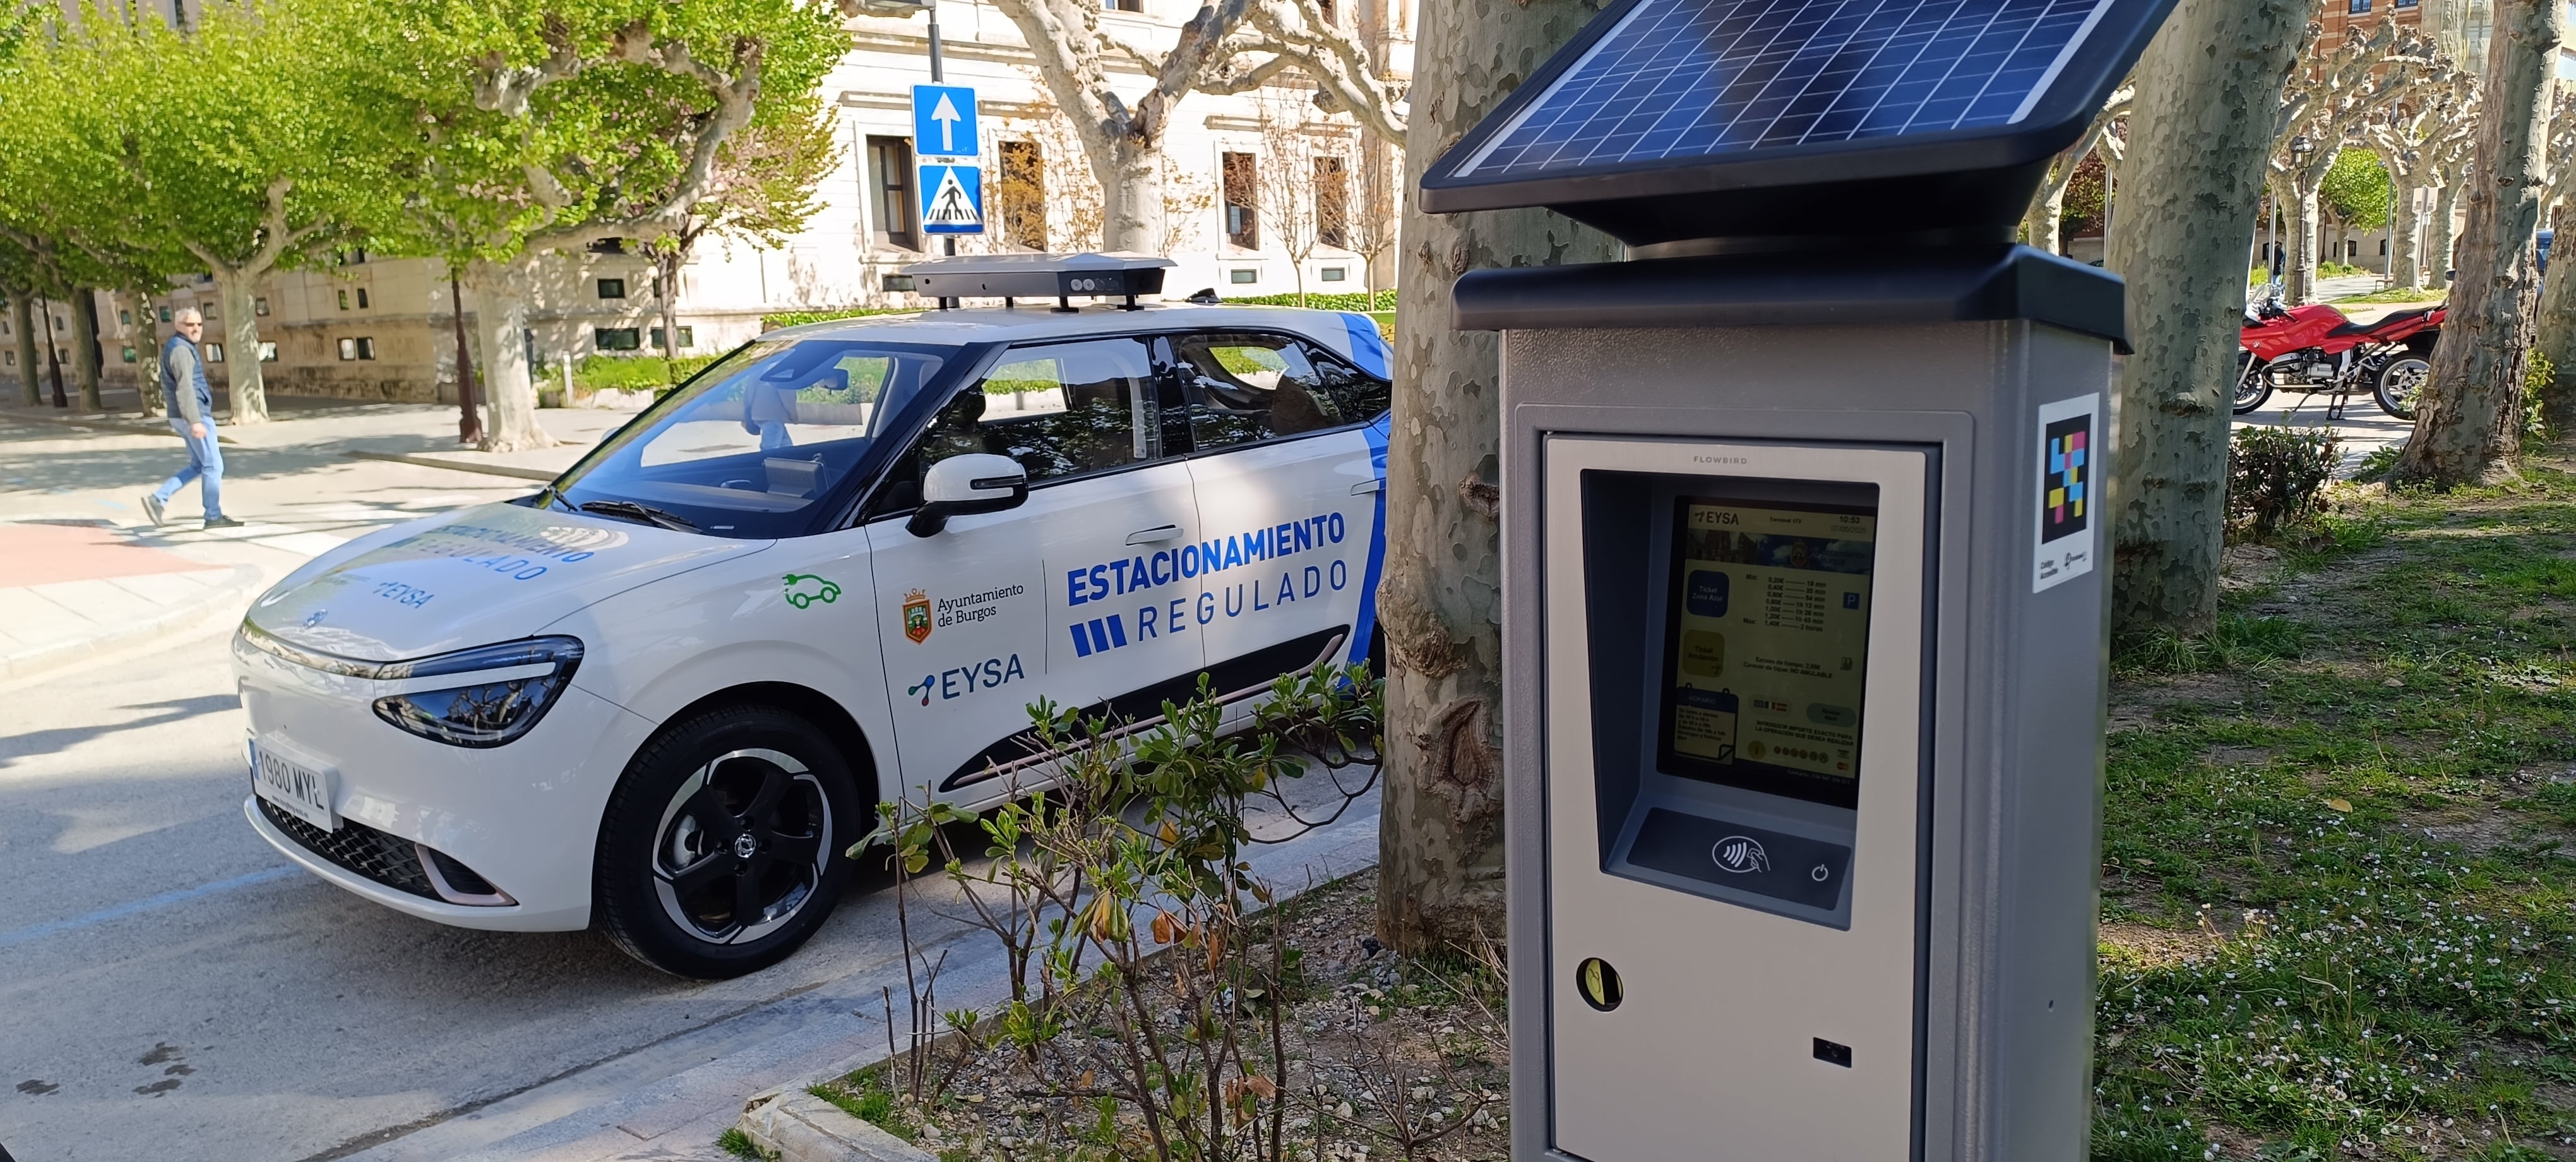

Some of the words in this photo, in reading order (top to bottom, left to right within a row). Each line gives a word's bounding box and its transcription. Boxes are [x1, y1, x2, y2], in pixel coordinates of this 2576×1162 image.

[1693, 456, 1748, 464] FLOWBIRD
[1707, 511, 1739, 525] EYSA
[1839, 515, 1860, 524] 10:53
[1067, 512, 1345, 607] ESTACIONAMIENTO
[382, 581, 435, 609] EYSA
[937, 583, 1024, 614] Ayuntamiento
[1138, 560, 1347, 641] REGULADO
[938, 613, 953, 628] de
[955, 605, 997, 626] Burgos
[942, 653, 1025, 700] EYSA
[259, 750, 291, 794] 1980
[292, 767, 325, 811] MYL
